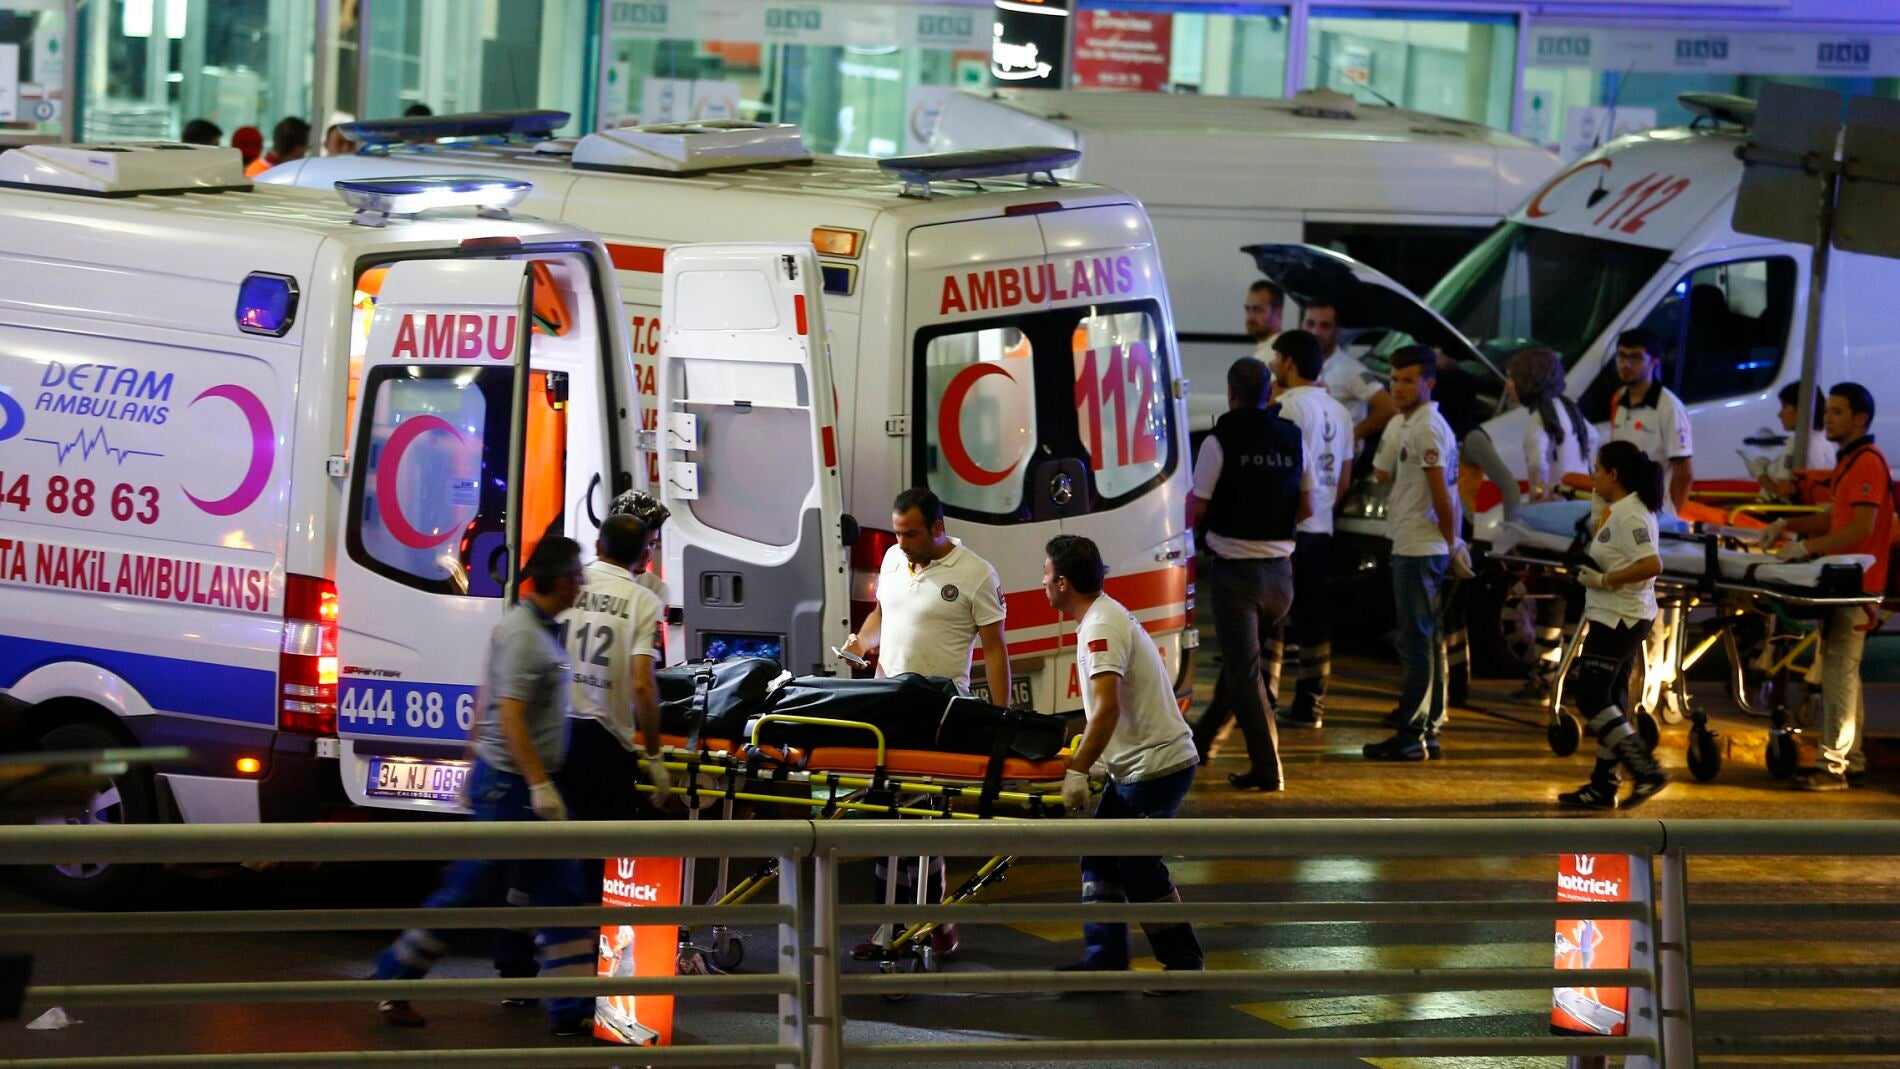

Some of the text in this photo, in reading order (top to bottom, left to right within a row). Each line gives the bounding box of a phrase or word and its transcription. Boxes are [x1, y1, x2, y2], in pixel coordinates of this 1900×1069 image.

[1593, 172, 1691, 235] 112
[940, 256, 1134, 315] AMBULANS
[392, 314, 516, 360] AMBU
[40, 360, 174, 401] DETAM
[35, 392, 170, 425] AMBULANS
[1075, 341, 1157, 471] 112
[46, 475, 96, 517] 88
[111, 483, 160, 524] 63
[115, 553, 269, 612] AMBULANSI
[342, 665, 401, 678] SPRINTER
[340, 687, 395, 726] 444
[405, 690, 444, 729] 88
[379, 765, 398, 788] 34
[406, 766, 428, 790] NJ
